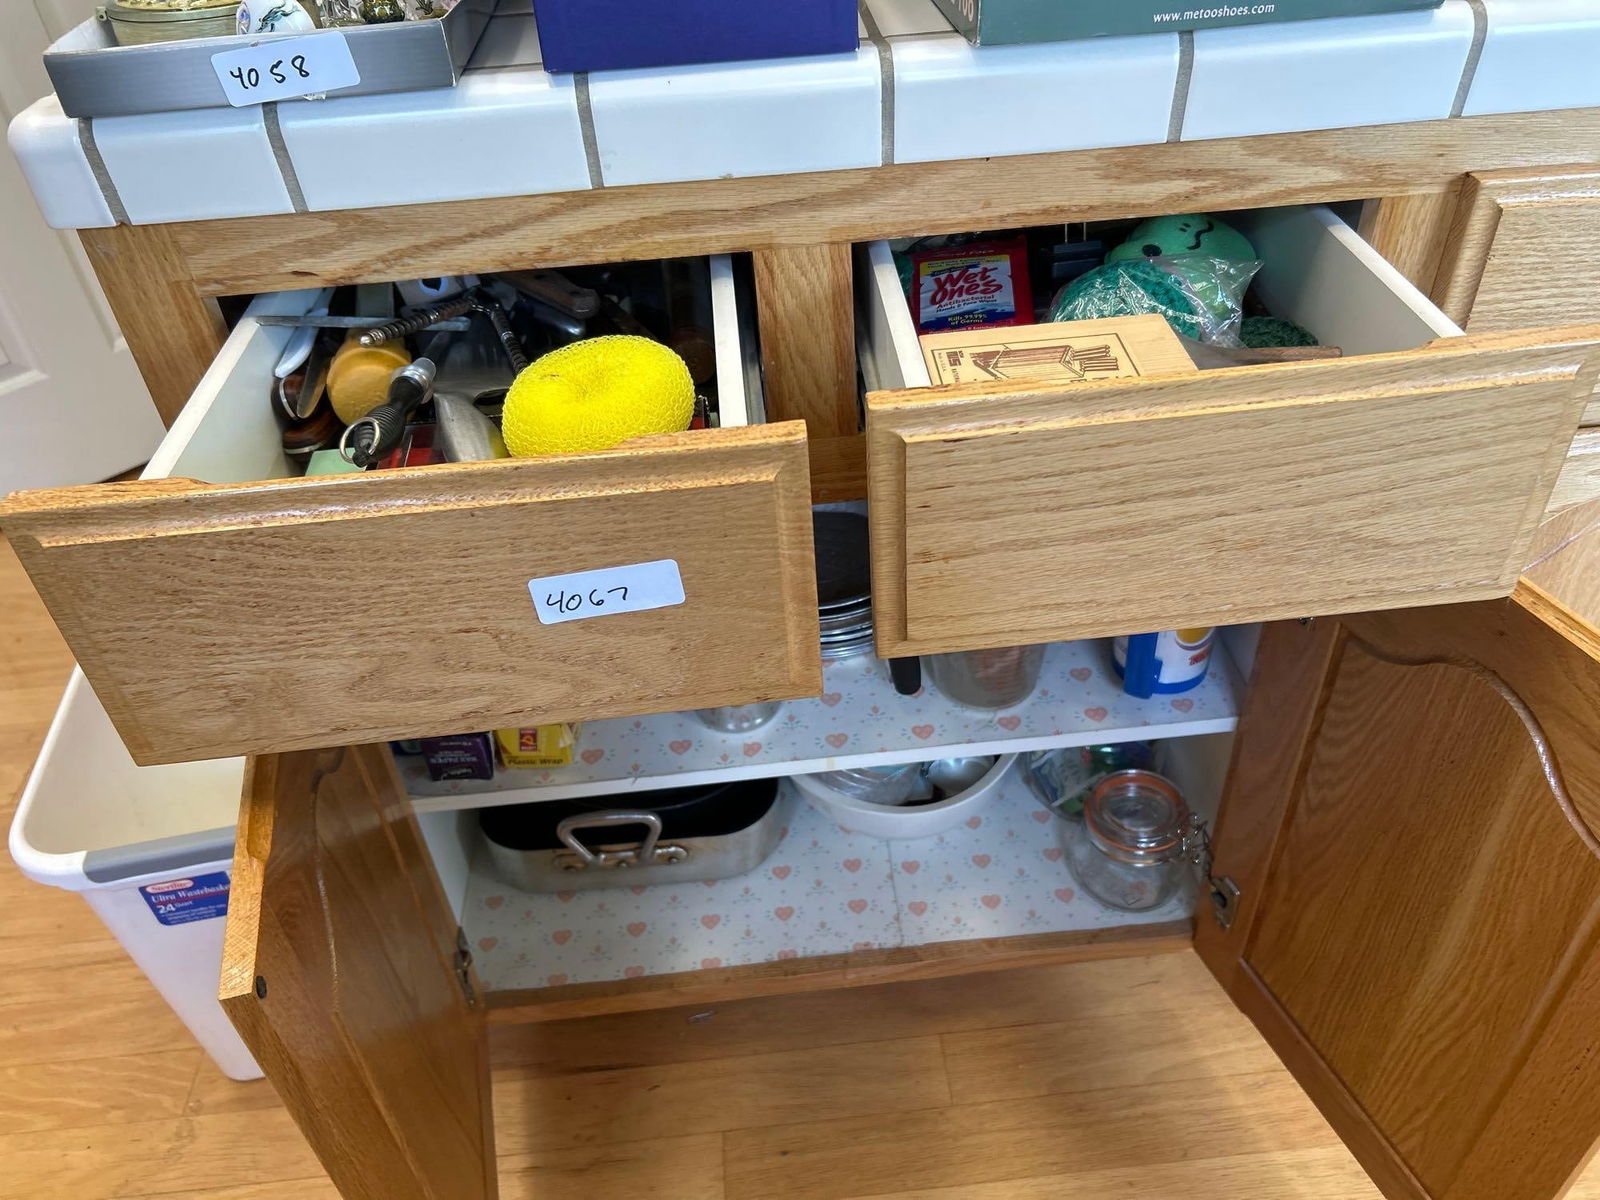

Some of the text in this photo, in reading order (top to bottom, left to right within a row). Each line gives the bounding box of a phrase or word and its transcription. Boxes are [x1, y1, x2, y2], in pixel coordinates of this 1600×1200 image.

[1153, 4, 1275, 23] www.metooshoes.com
[230, 55, 310, 89] 4058
[934, 267, 998, 288] Wet
[546, 586, 628, 613] 4067
[540, 758, 563, 766] Wrap
[151, 883, 230, 904] Ultra Wastebaske
[159, 903, 176, 914] 24
